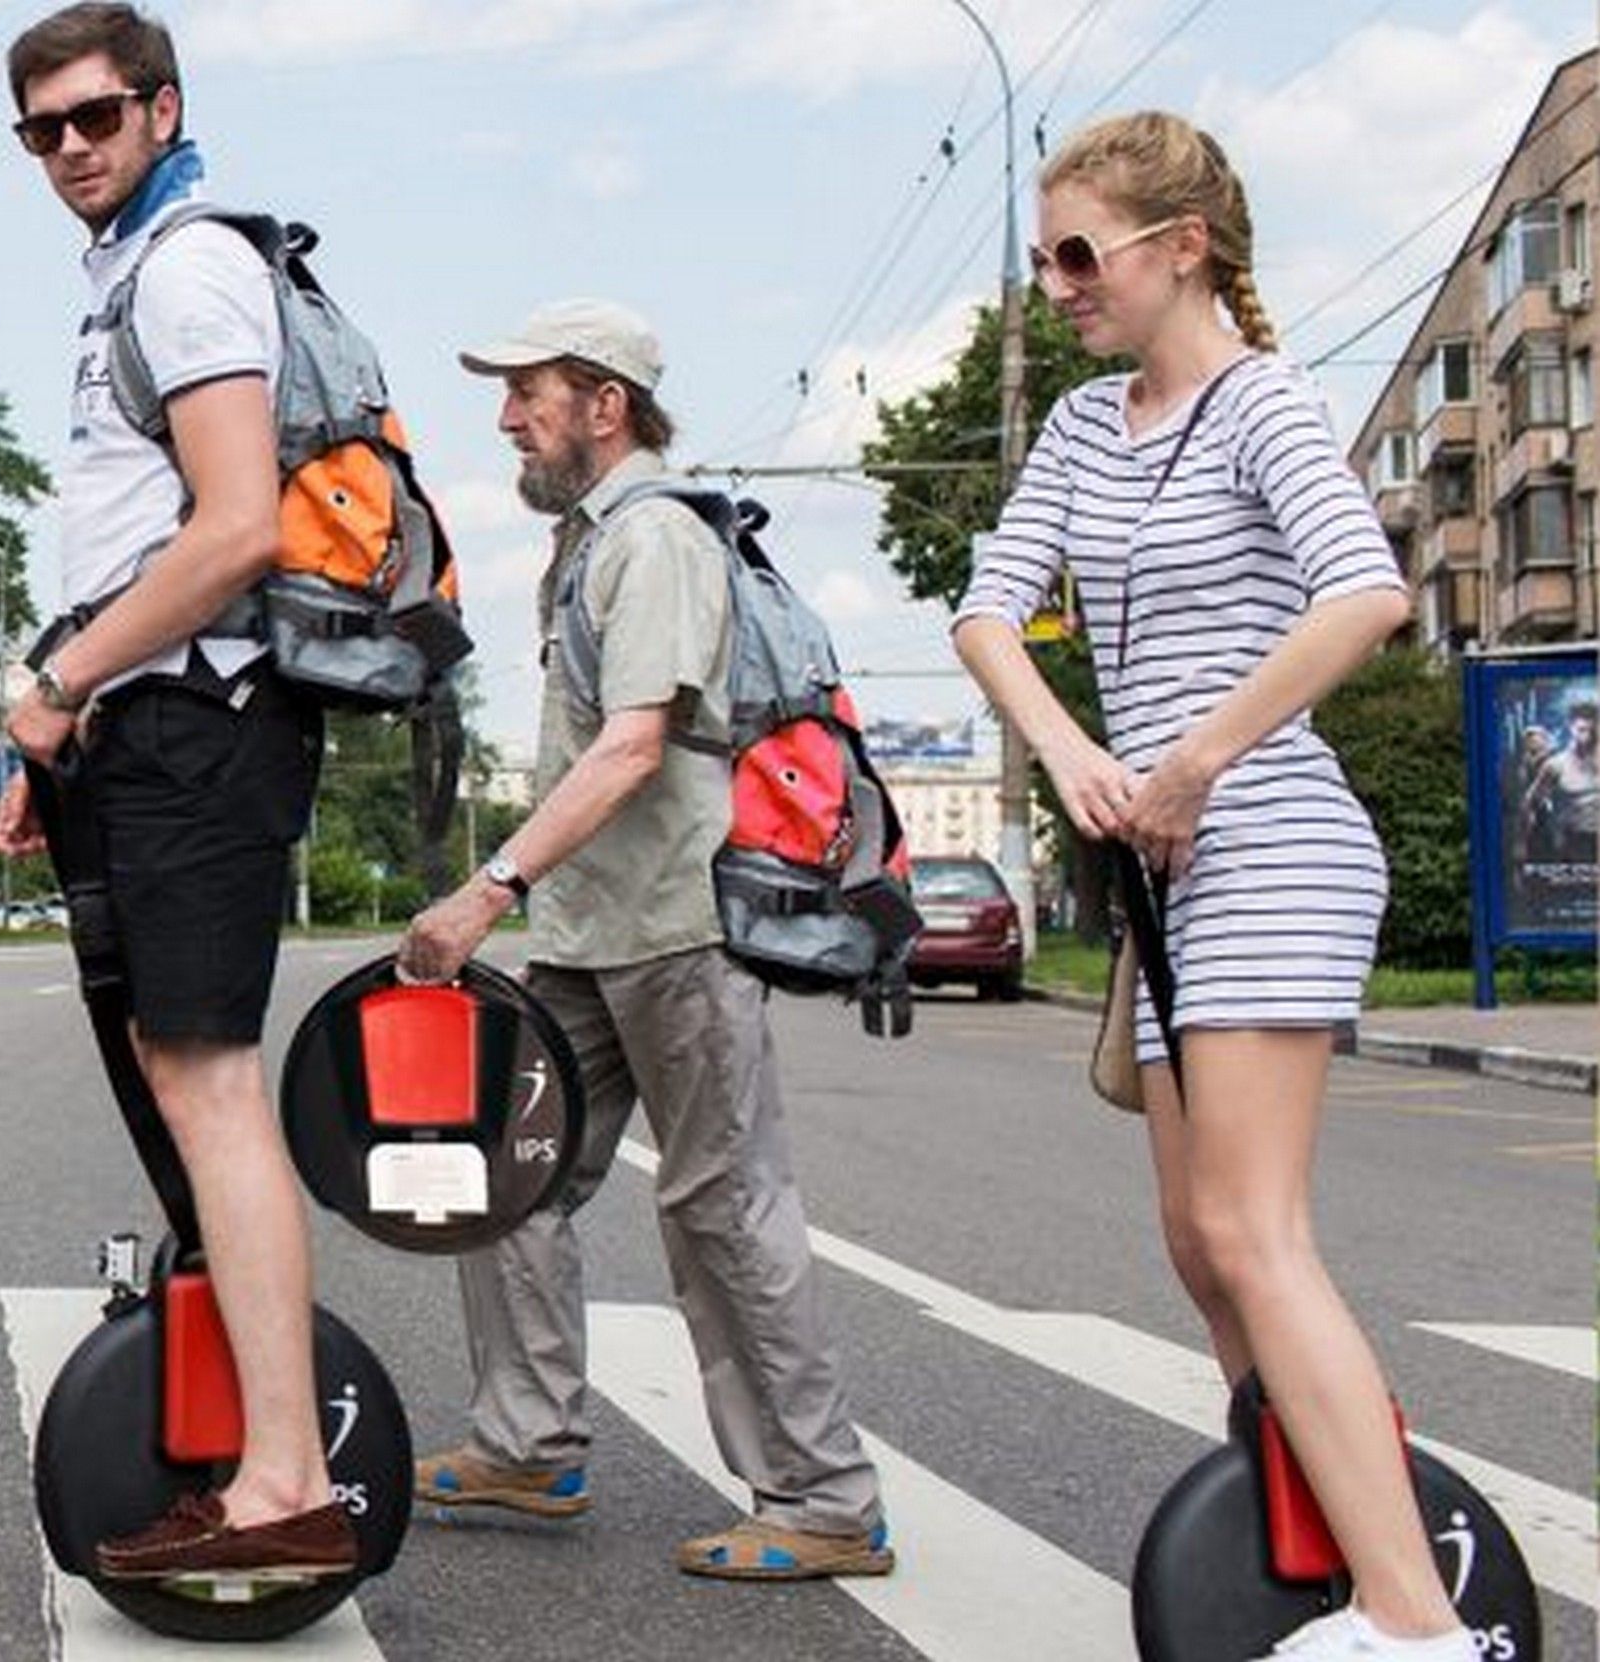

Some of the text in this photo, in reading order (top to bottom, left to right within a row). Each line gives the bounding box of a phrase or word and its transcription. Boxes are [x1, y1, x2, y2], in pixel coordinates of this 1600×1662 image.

[515, 1138, 557, 1163] IPS
[329, 1484, 368, 1515] PS
[1466, 1624, 1516, 1662] PS
